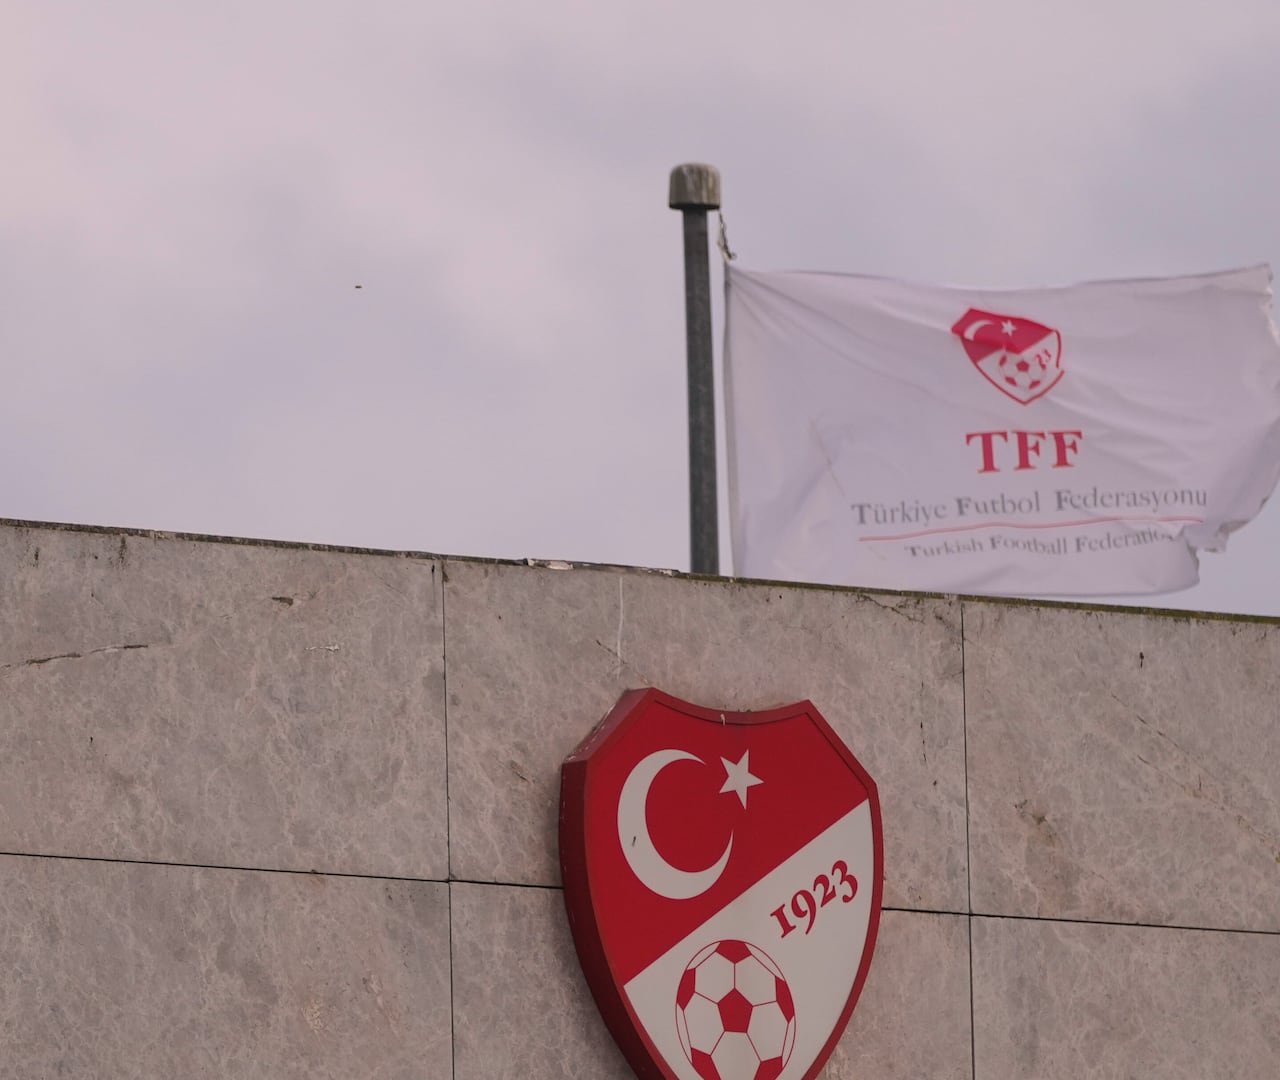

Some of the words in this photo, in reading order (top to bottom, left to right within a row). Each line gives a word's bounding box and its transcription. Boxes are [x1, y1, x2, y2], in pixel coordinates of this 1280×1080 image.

[966, 429, 1083, 473] TFF
[851, 500, 947, 527] Türkiye
[954, 489, 1040, 516] Futbol
[1055, 487, 1208, 513] Federasyonu
[904, 537, 984, 557] Turkish
[989, 534, 1068, 555] Football
[769, 859, 858, 939] 1923
